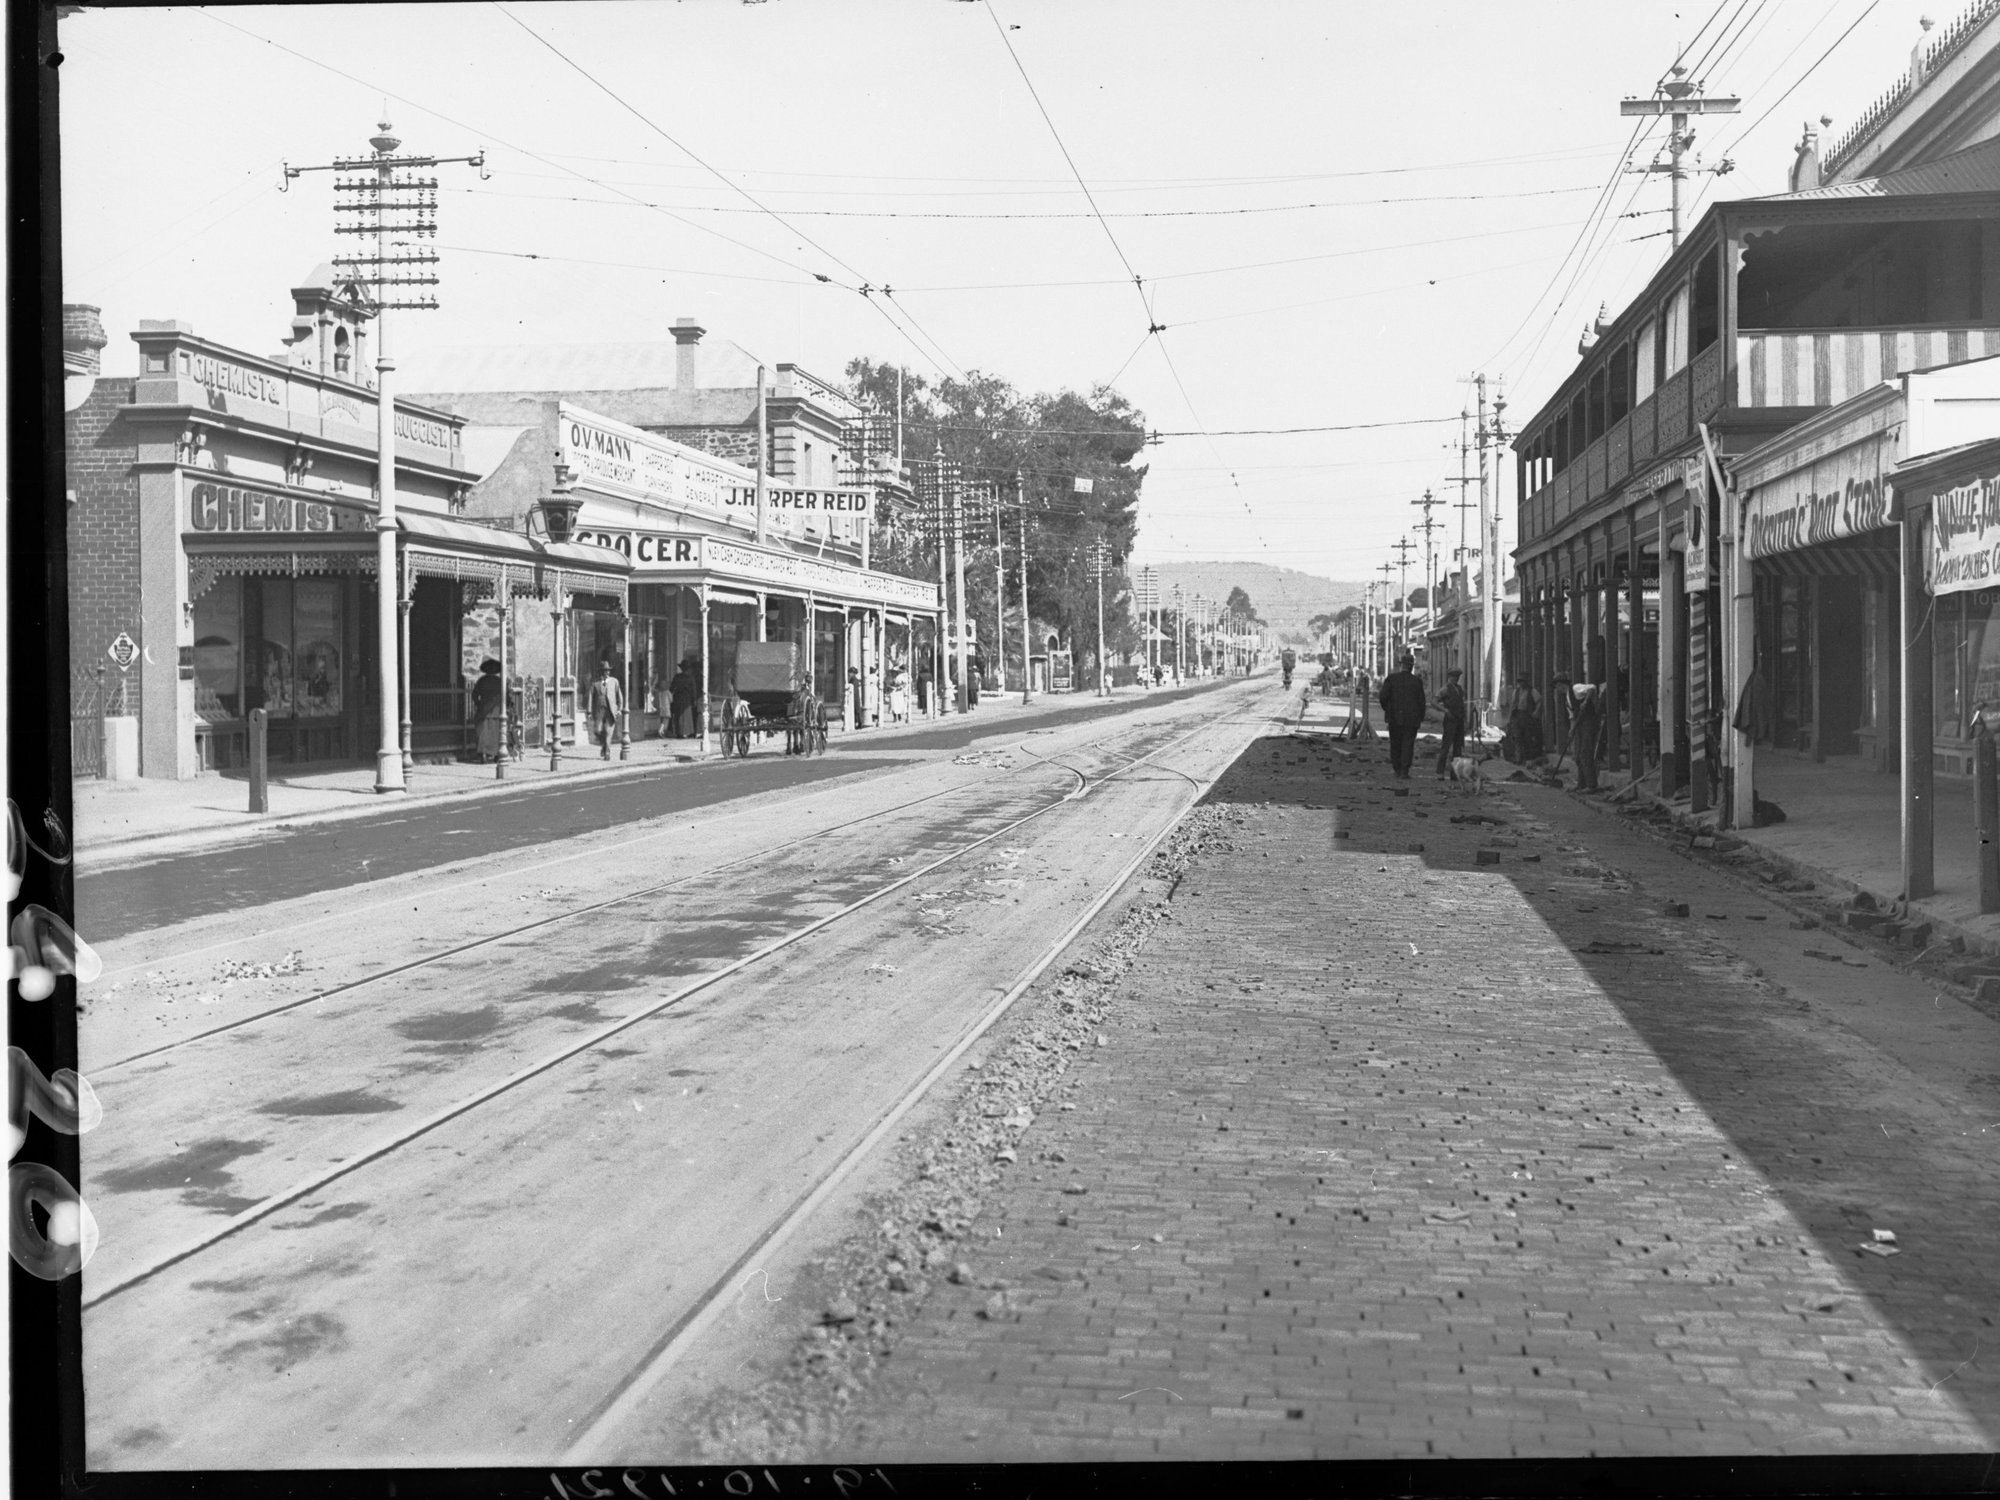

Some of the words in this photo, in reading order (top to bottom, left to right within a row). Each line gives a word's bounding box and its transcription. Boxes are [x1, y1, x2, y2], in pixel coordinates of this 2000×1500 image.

[194, 357, 270, 401] CHEMIST
[725, 487, 818, 510] J.HRPER
[823, 492, 867, 512] REID
